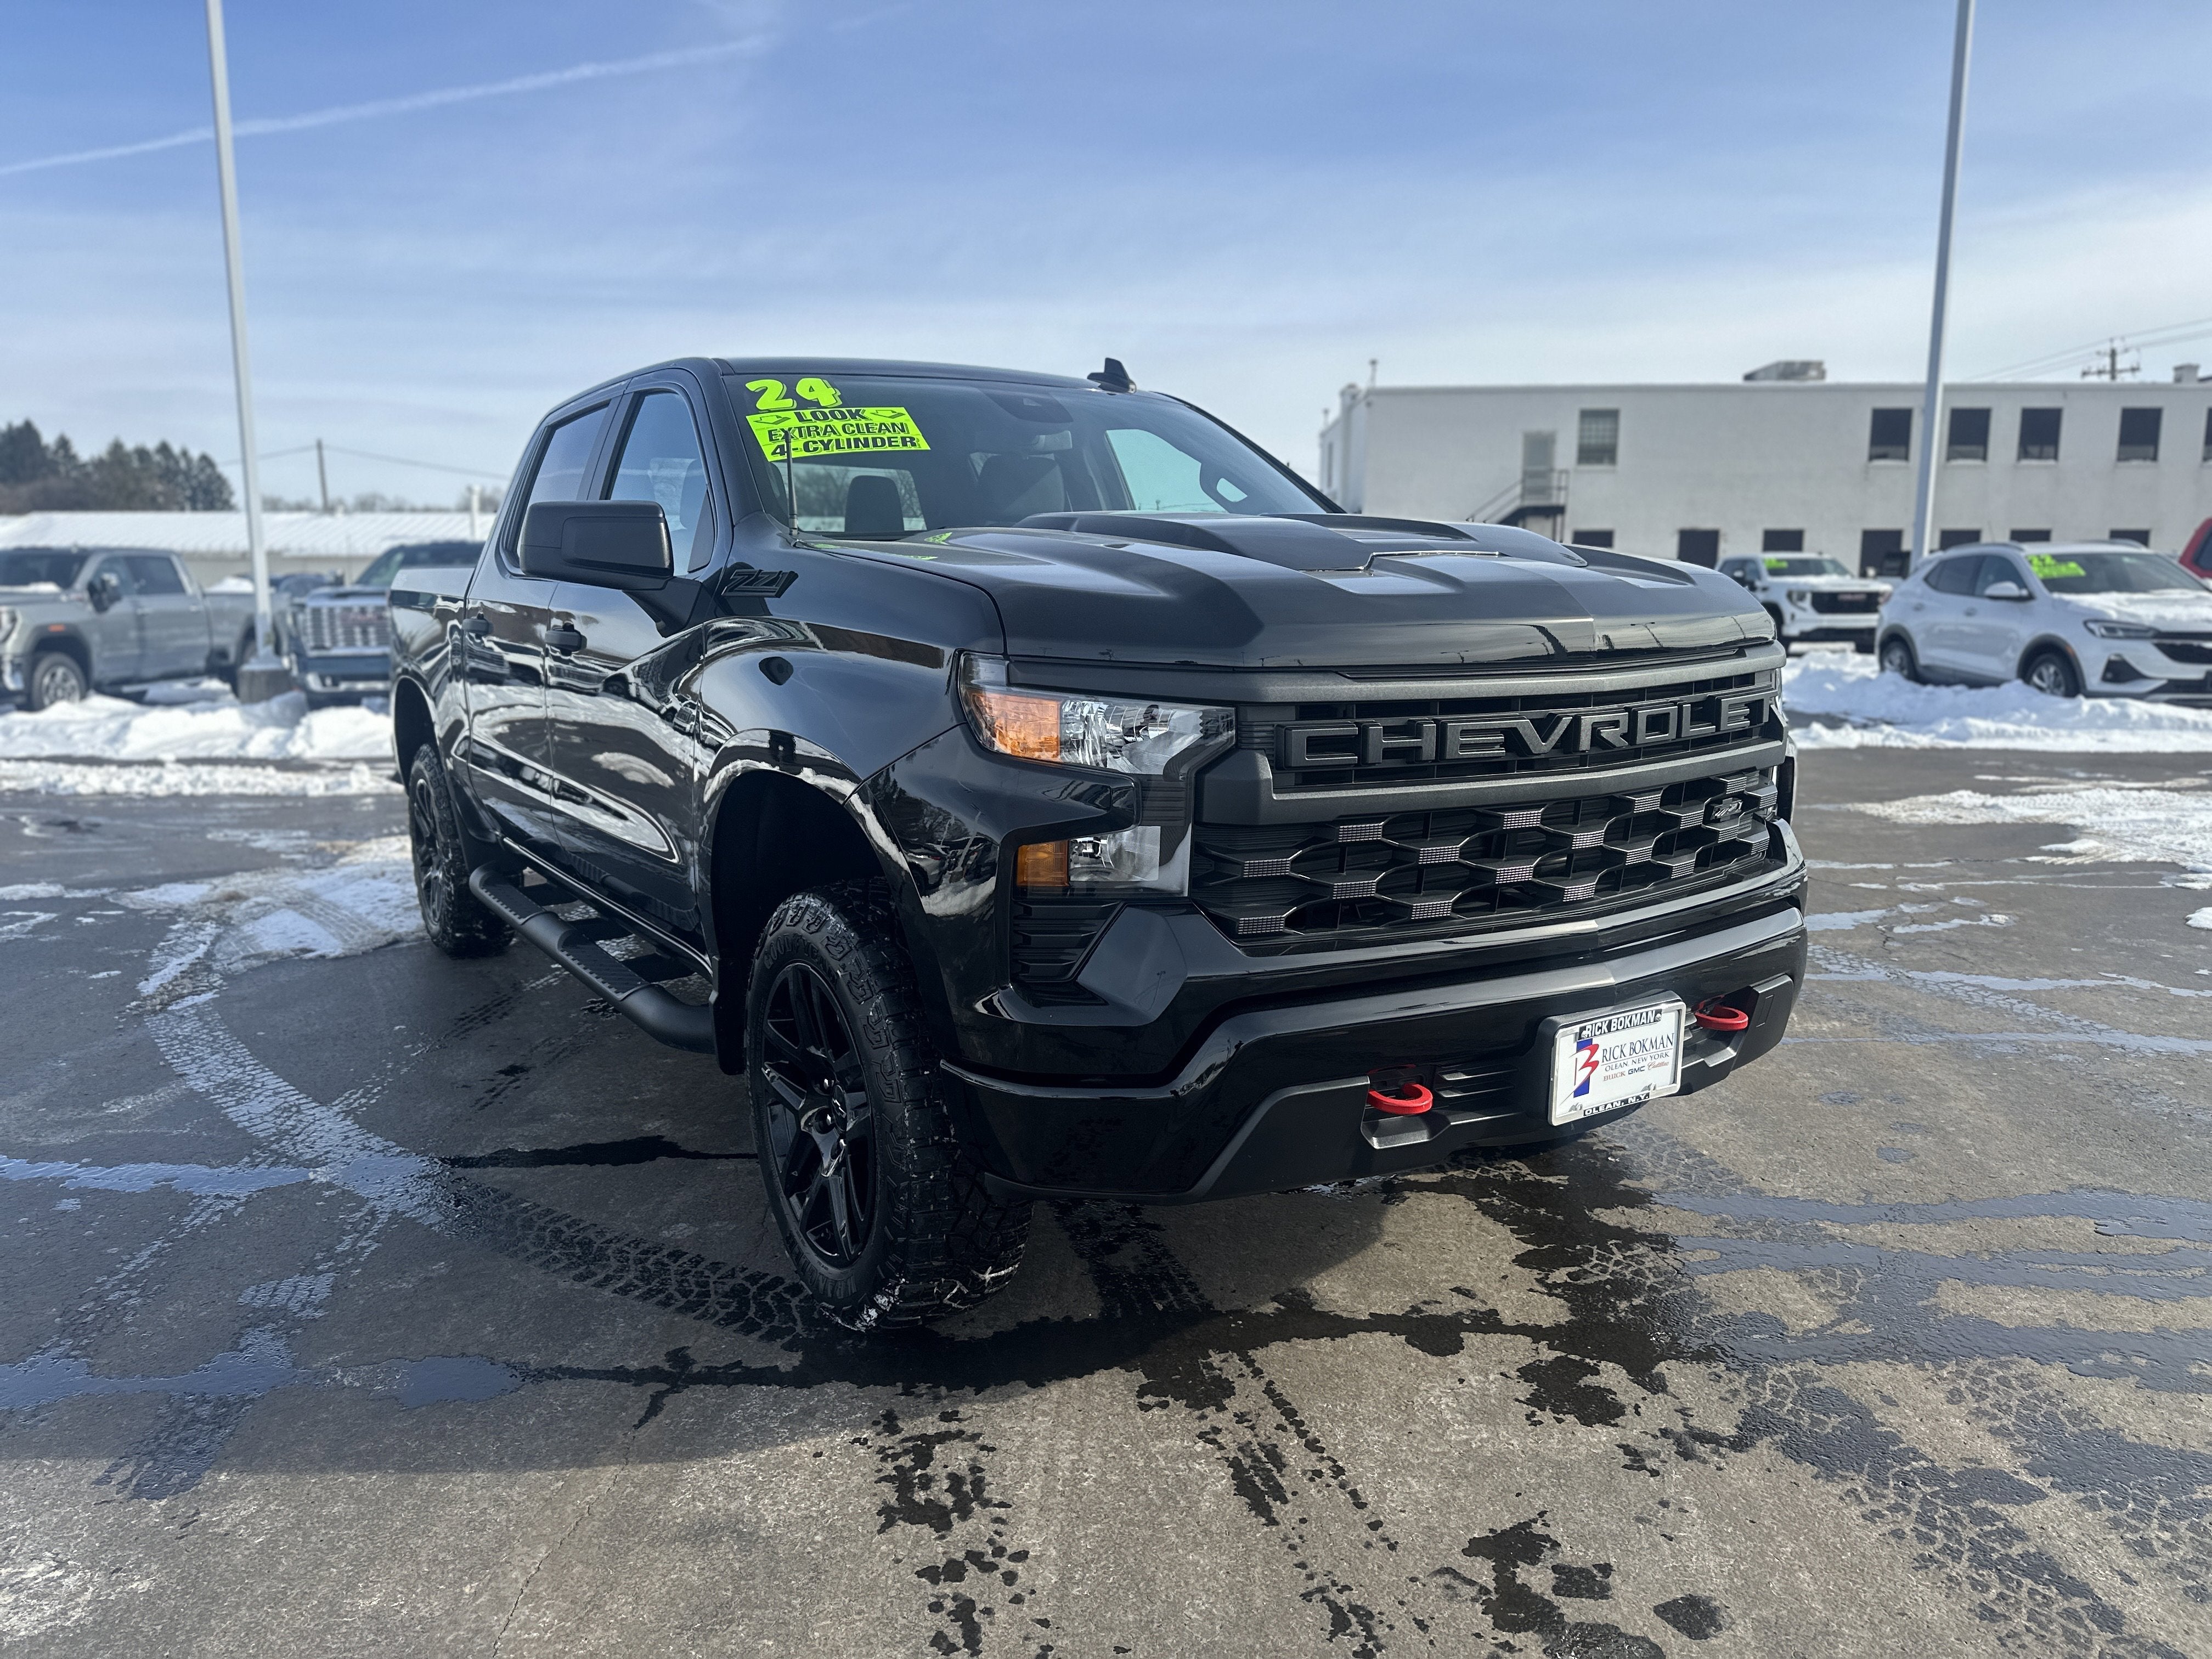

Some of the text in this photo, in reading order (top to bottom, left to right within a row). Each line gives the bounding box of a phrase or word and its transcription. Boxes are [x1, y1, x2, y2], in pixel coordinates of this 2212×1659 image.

[746, 377, 842, 411] 24
[793, 408, 870, 424] LOOK
[768, 422, 909, 442] EXTRA CLEAN
[1277, 692, 1776, 767] CHEVROLET
[1585, 1010, 1656, 1037] RICK BOKMAN
[1601, 1033, 1674, 1063] RICK BOKMAN
[1605, 1051, 1669, 1072] OLEAN, NEW YORK
[1603, 1071, 1626, 1082] BUICK
[1628, 1066, 1645, 1075] GMC
[1628, 1093, 1649, 1104] N.Y.
